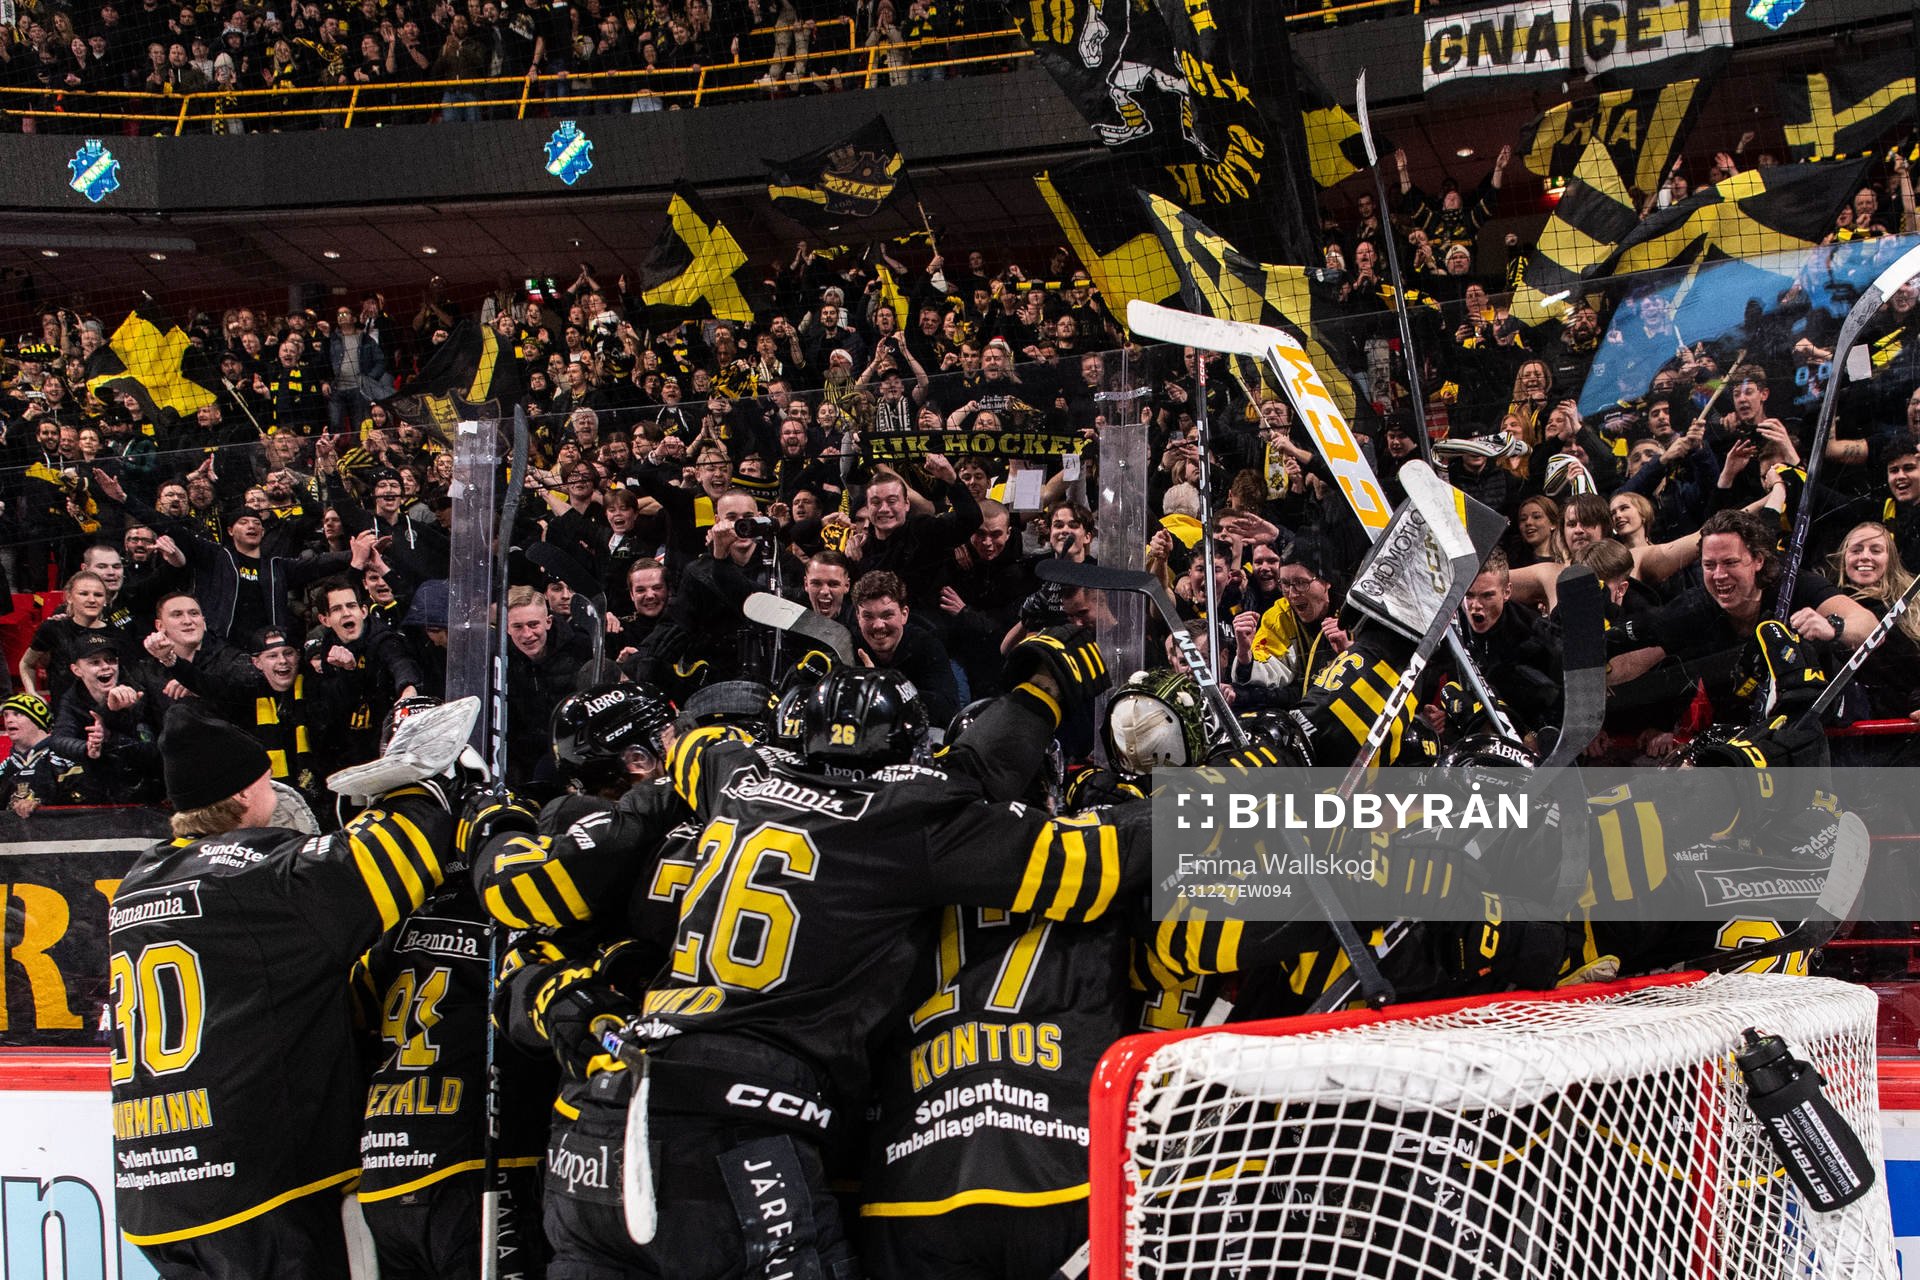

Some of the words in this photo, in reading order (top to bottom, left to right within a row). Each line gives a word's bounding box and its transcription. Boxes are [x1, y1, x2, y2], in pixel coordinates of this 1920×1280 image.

[1430, 0, 1704, 74] GNAGET
[870, 435, 929, 453] AIK
[943, 433, 1091, 455] HOCKEY
[1276, 344, 1391, 529] CCM
[1173, 630, 1217, 686] CCM
[1849, 599, 1907, 671] CCM
[584, 690, 625, 717] ÅBRO
[1367, 652, 1426, 747] CCM
[606, 722, 633, 742] CCM
[831, 724, 856, 745] 26
[1475, 774, 1510, 787] CCM
[209, 854, 247, 869] Måleri
[671, 816, 820, 993] 26
[1714, 873, 1827, 900] Bemannia
[109, 891, 187, 931] Bemannia
[109, 940, 206, 1085] 30
[910, 1021, 1063, 1093] KONTOS
[725, 1082, 833, 1130] CCM
[915, 1078, 1050, 1125] Sollentuna
[886, 1105, 1091, 1165] Emballagehantering
[1770, 1117, 1800, 1147] YOU
[1791, 1144, 1836, 1205] BETTER
[1823, 1155, 1853, 1196] Naturliga
